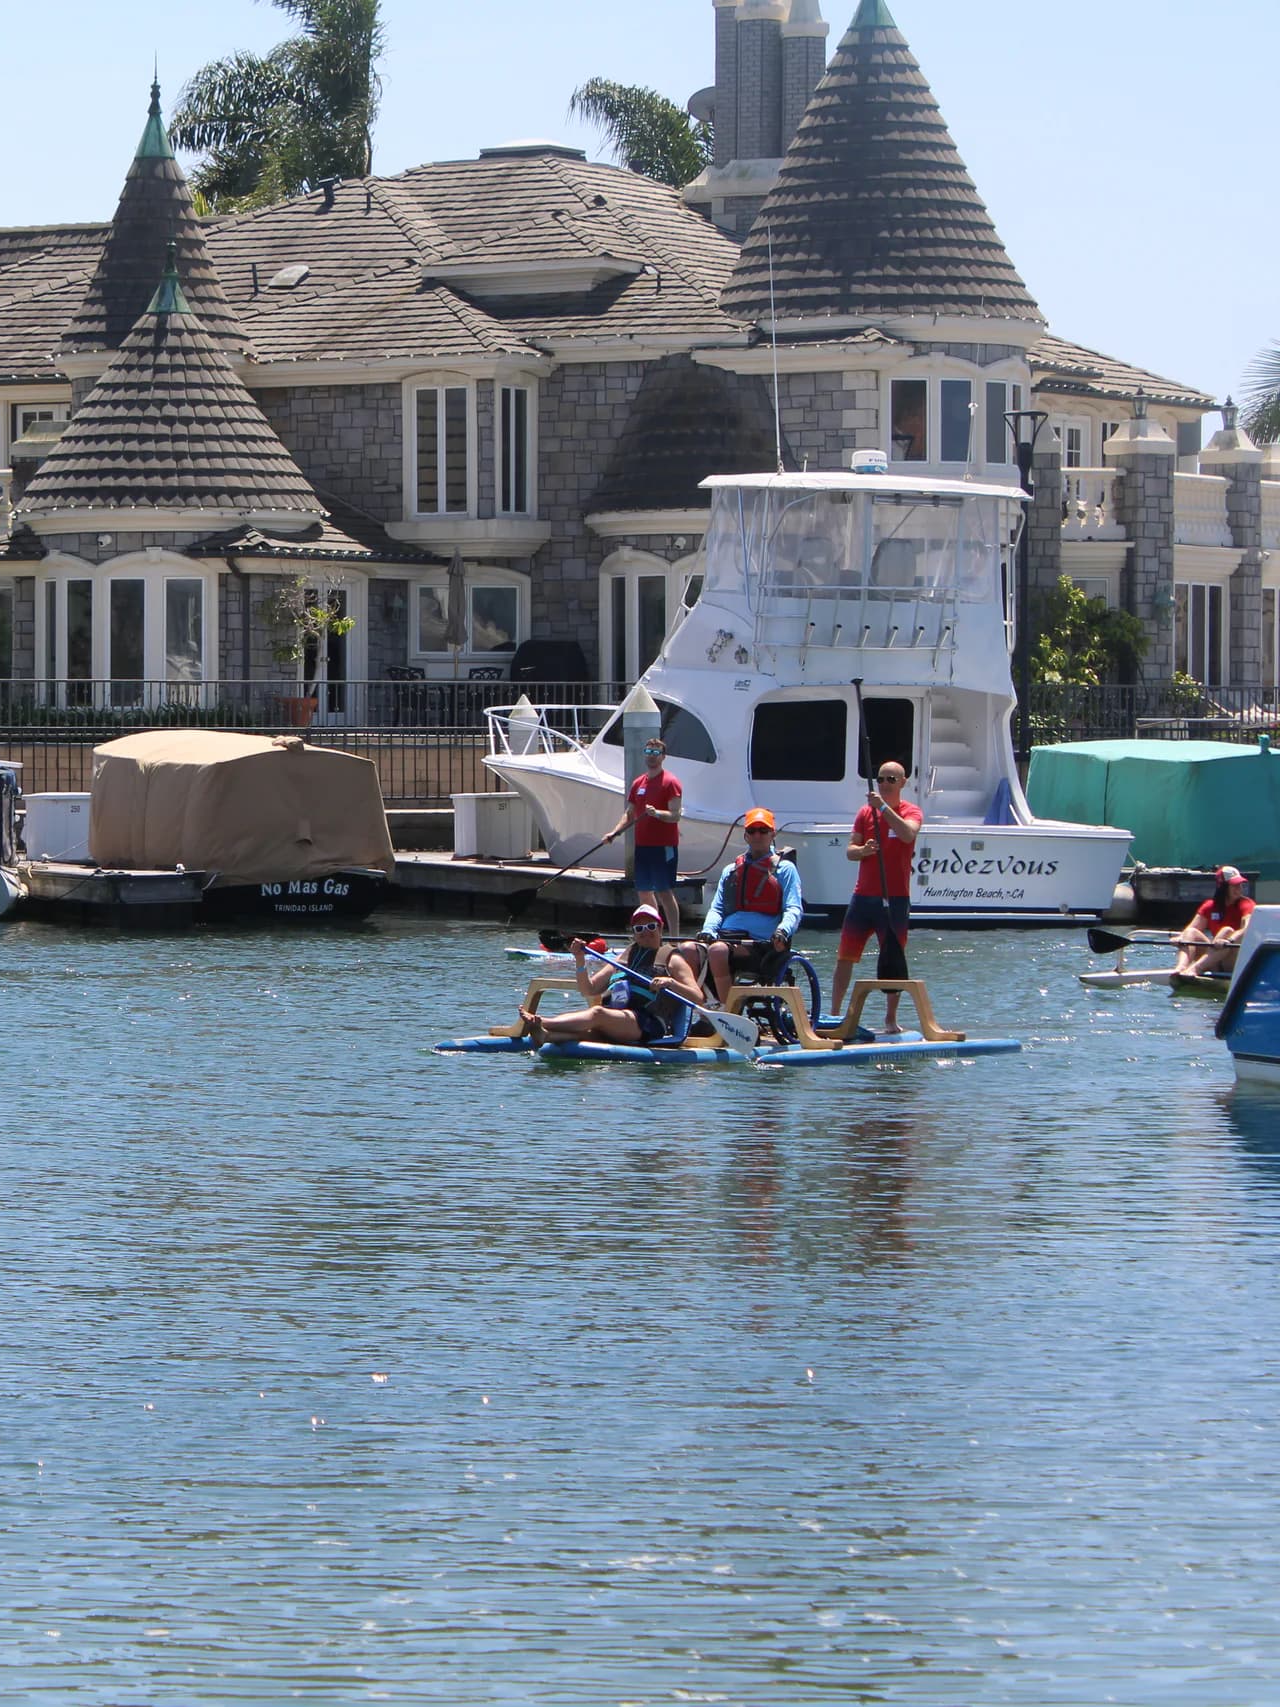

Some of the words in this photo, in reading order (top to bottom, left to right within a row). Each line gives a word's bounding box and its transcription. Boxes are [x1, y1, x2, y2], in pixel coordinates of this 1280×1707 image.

[911, 848, 1059, 876] endezvous
[261, 883, 281, 896] No
[288, 880, 318, 894] Mas
[323, 879, 349, 895] Gas
[923, 887, 973, 900] Huntington
[274, 904, 307, 912] TRINIDAD
